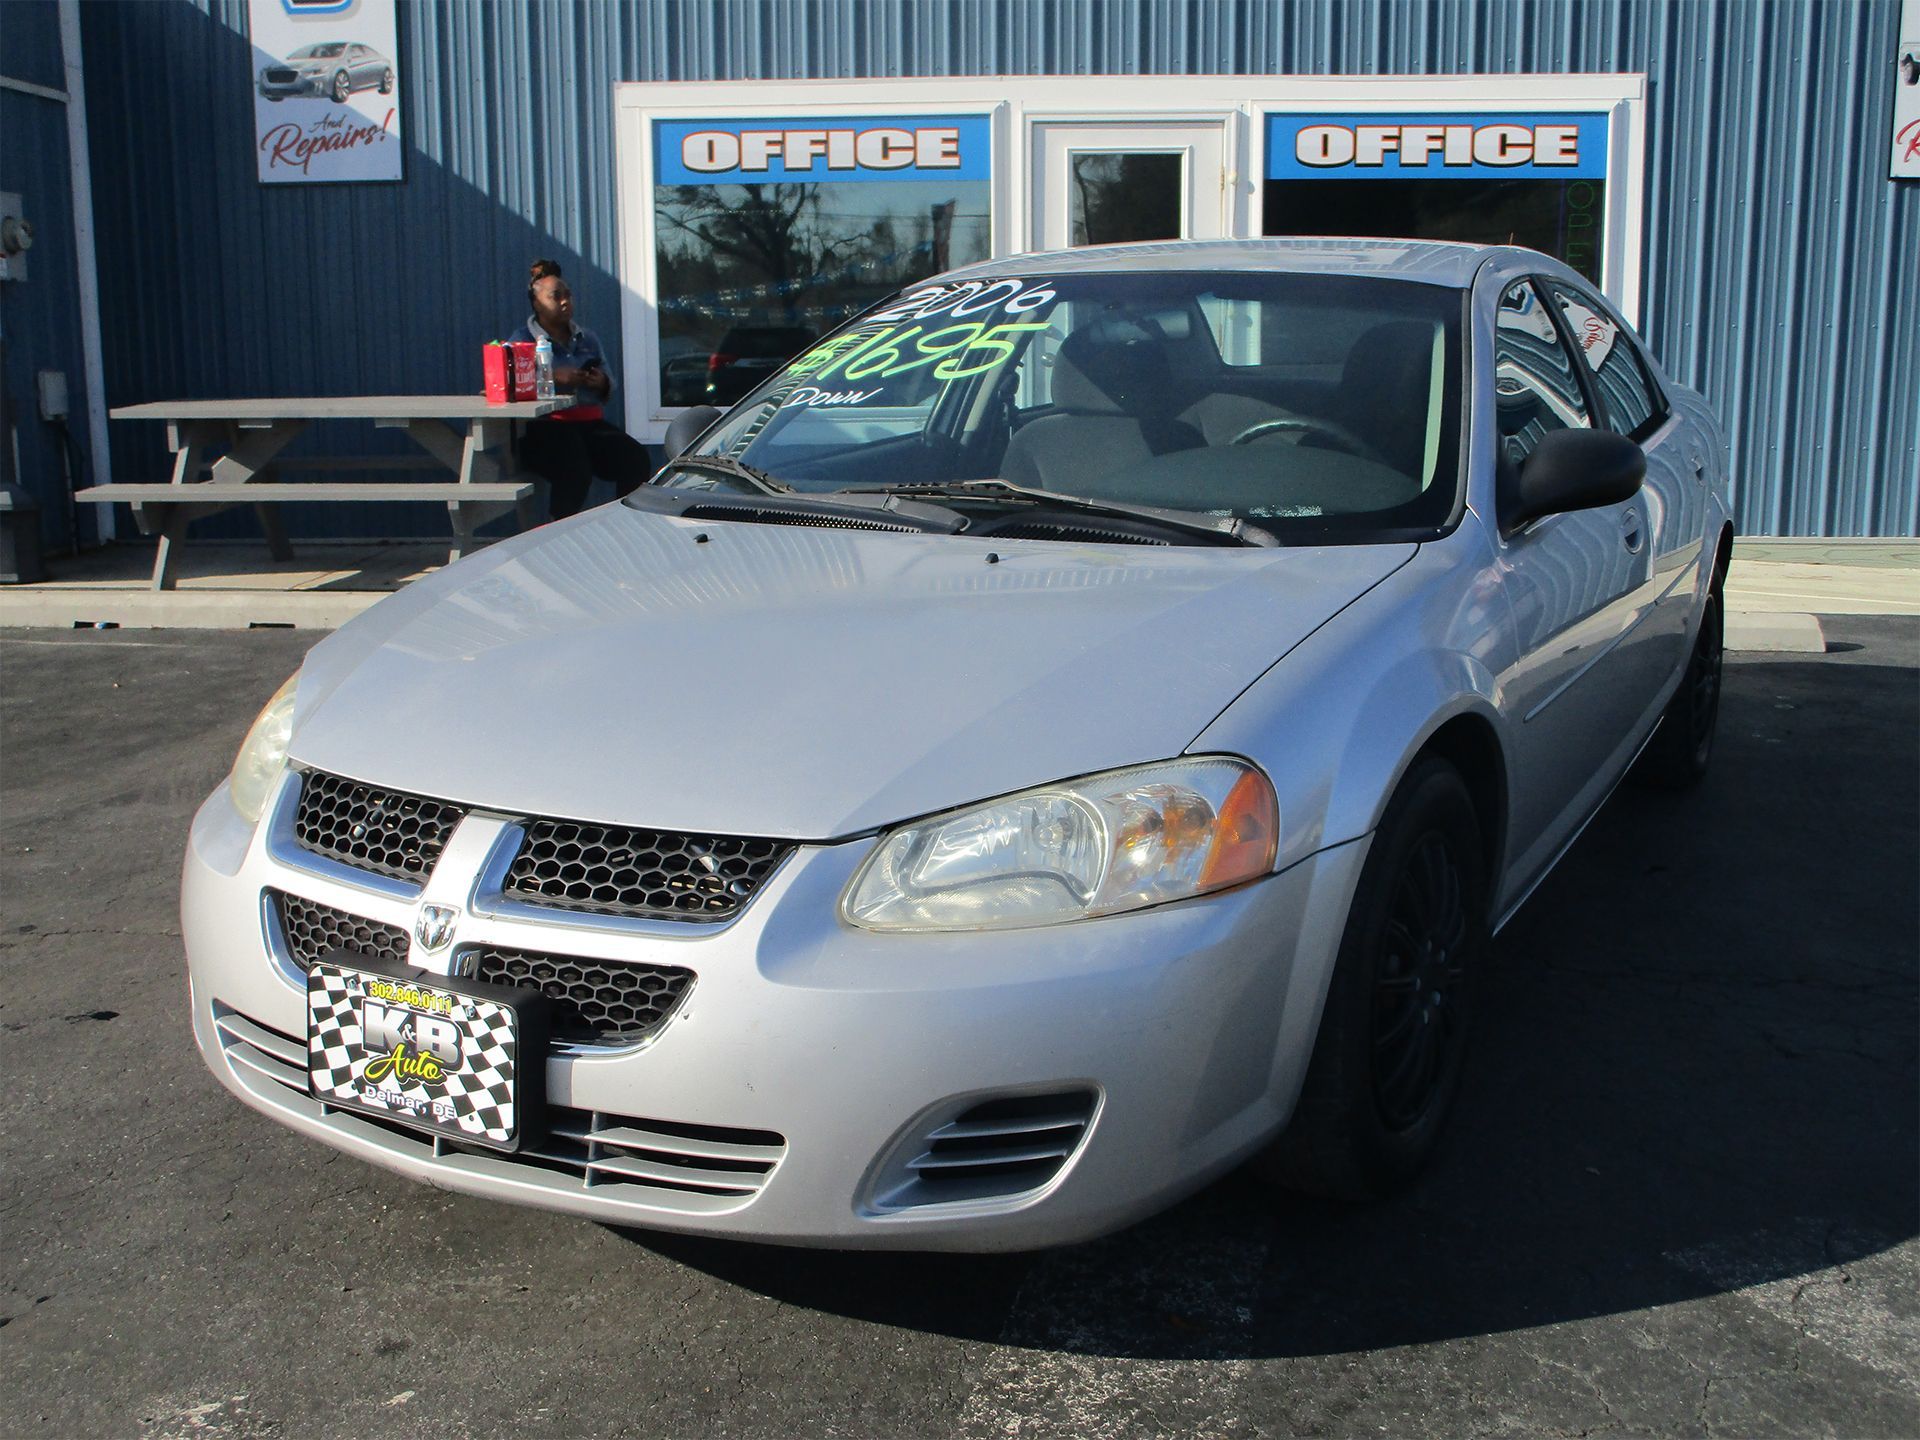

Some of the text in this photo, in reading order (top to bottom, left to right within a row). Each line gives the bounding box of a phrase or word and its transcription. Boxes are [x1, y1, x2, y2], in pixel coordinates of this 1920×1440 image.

[260, 108, 395, 175] Repairs!
[309, 112, 347, 133] And
[681, 127, 961, 174] OFFICE
[1295, 124, 1579, 168] OFFICE
[1566, 181, 1594, 277] OPE
[865, 279, 1056, 322] 2006
[788, 323, 1052, 381] $1695
[370, 981, 452, 1015] 302.846.0111
[363, 1001, 464, 1072] K&B
[365, 1043, 444, 1081] Auto
[365, 1085, 458, 1120] Delmar, DE
